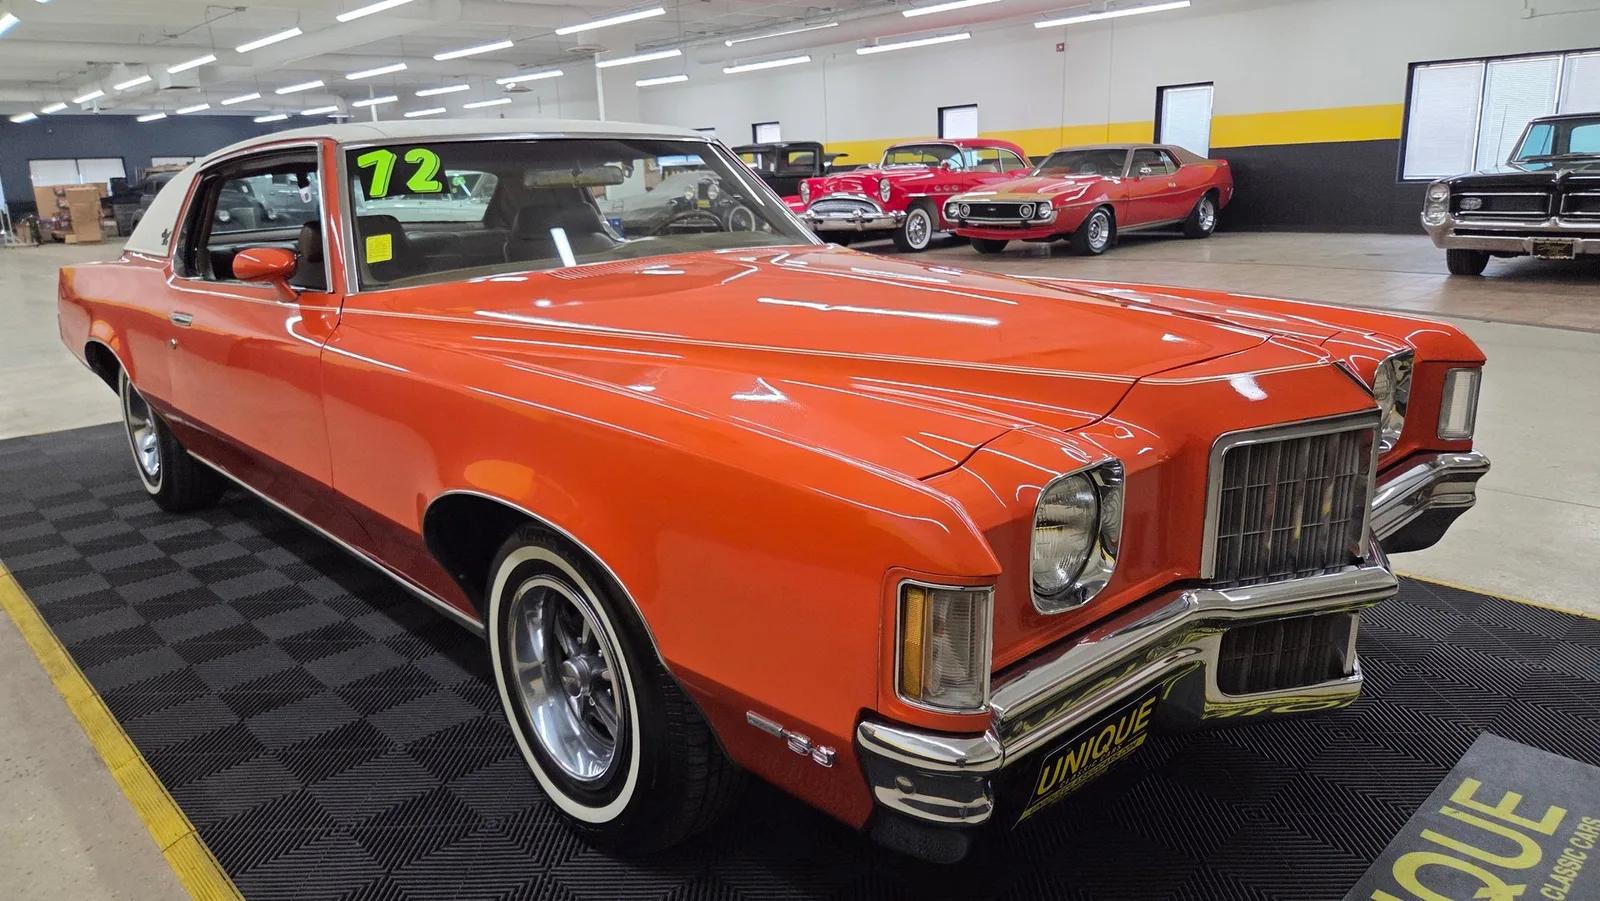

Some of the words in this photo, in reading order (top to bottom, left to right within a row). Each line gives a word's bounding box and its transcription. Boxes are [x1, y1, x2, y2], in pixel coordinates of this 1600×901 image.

[357, 148, 443, 198] 72
[1037, 696, 1157, 795] UNIQUE
[1371, 777, 1568, 901] QUE
[1540, 847, 1588, 901] CLASSIC
[1569, 816, 1600, 849] CARS
